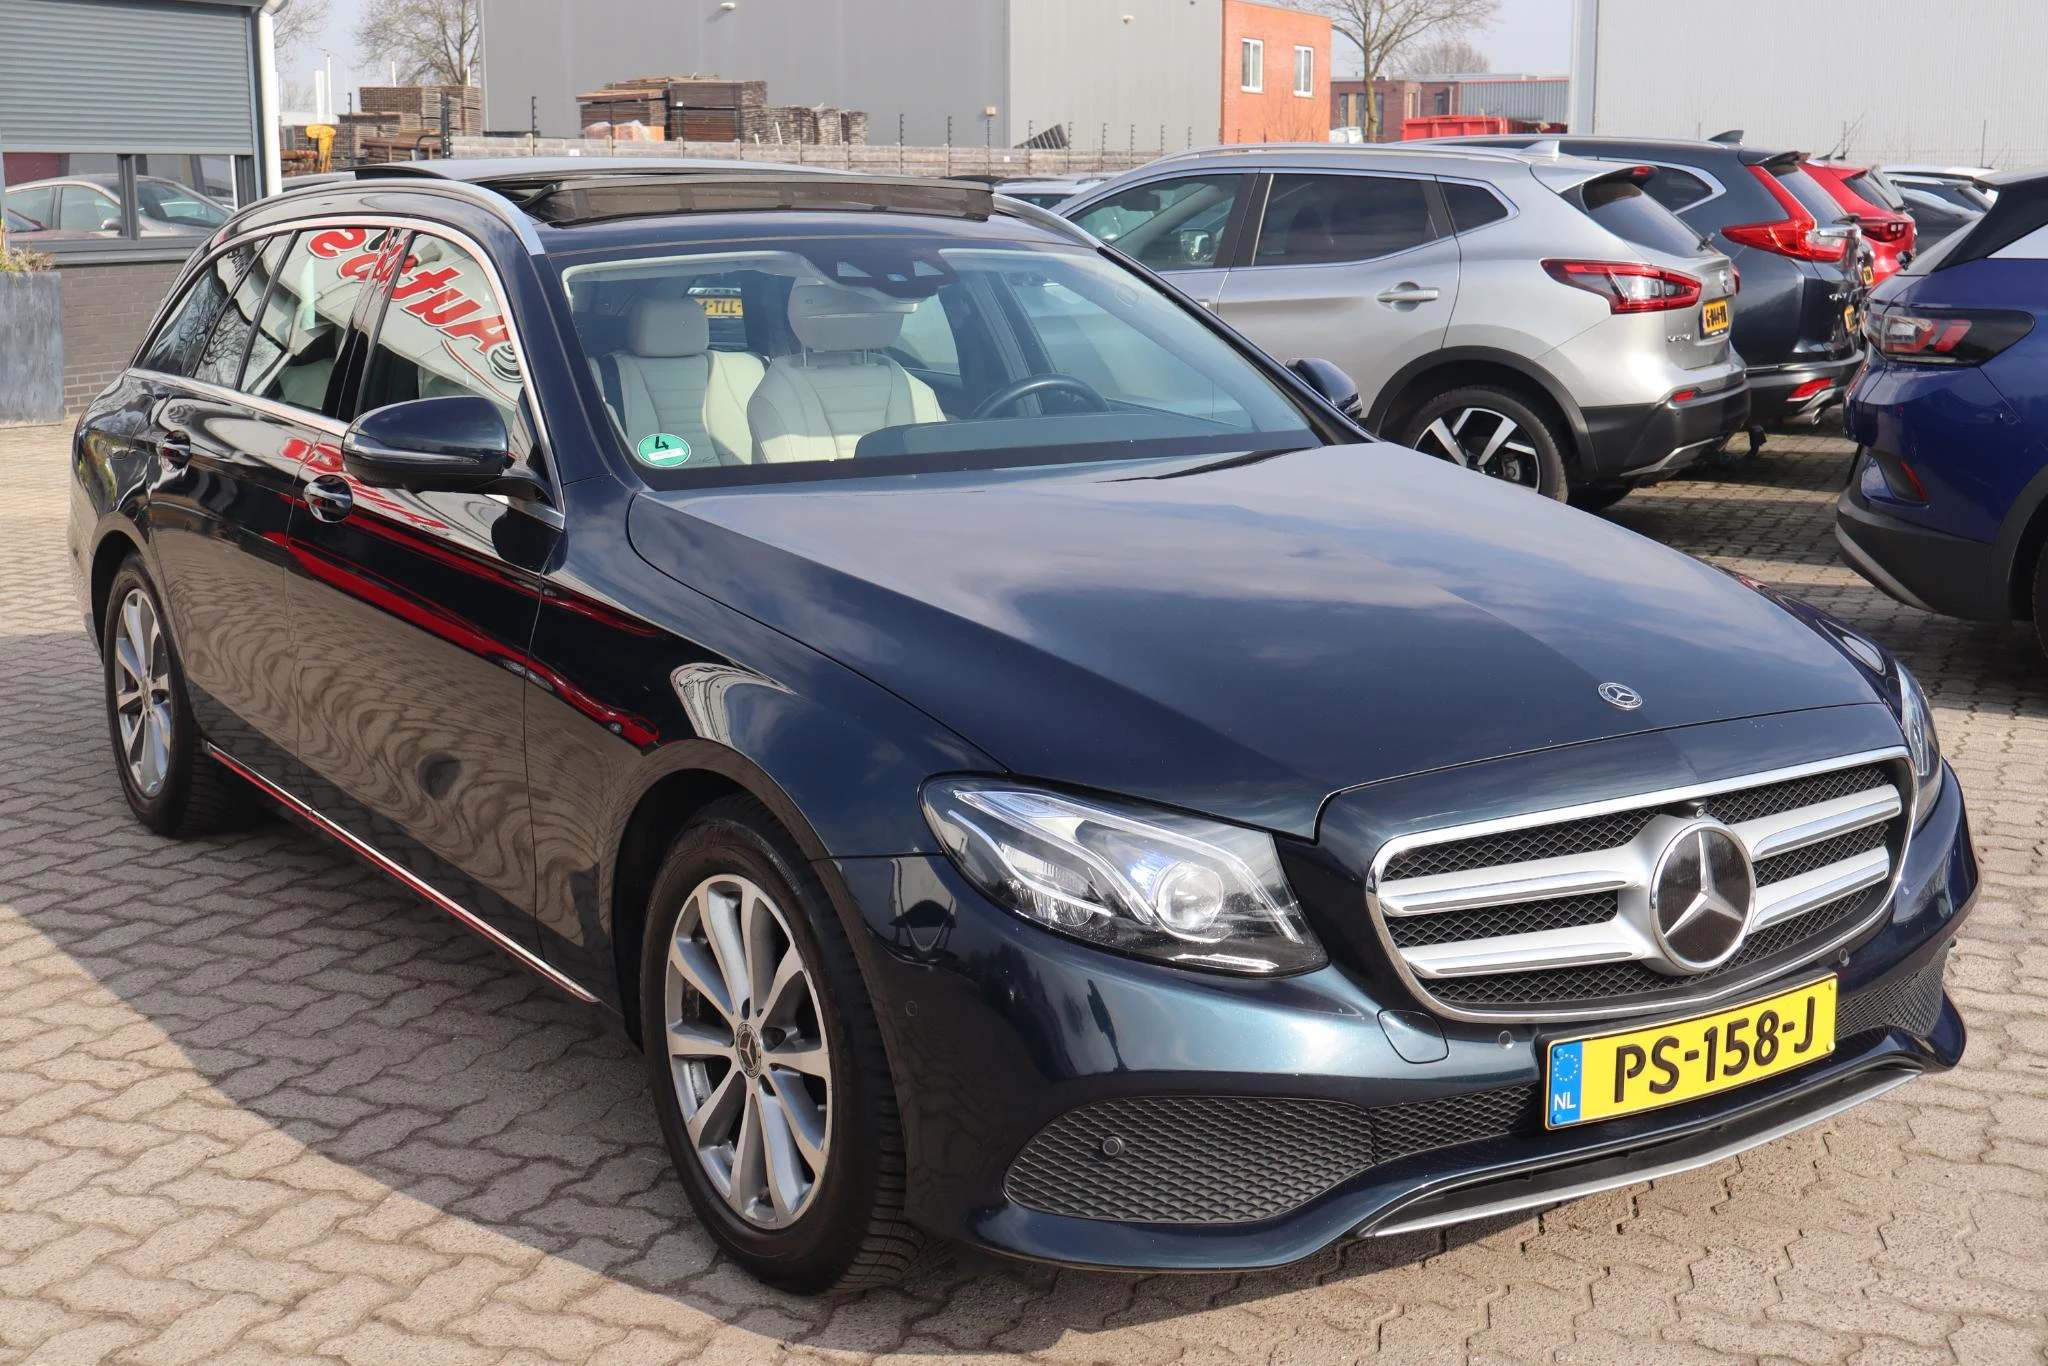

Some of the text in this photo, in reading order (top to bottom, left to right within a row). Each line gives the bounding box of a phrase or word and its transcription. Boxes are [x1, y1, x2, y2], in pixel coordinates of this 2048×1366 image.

[655, 436, 669, 449] 4
[1553, 996, 1816, 1112] NL PS-158-J
